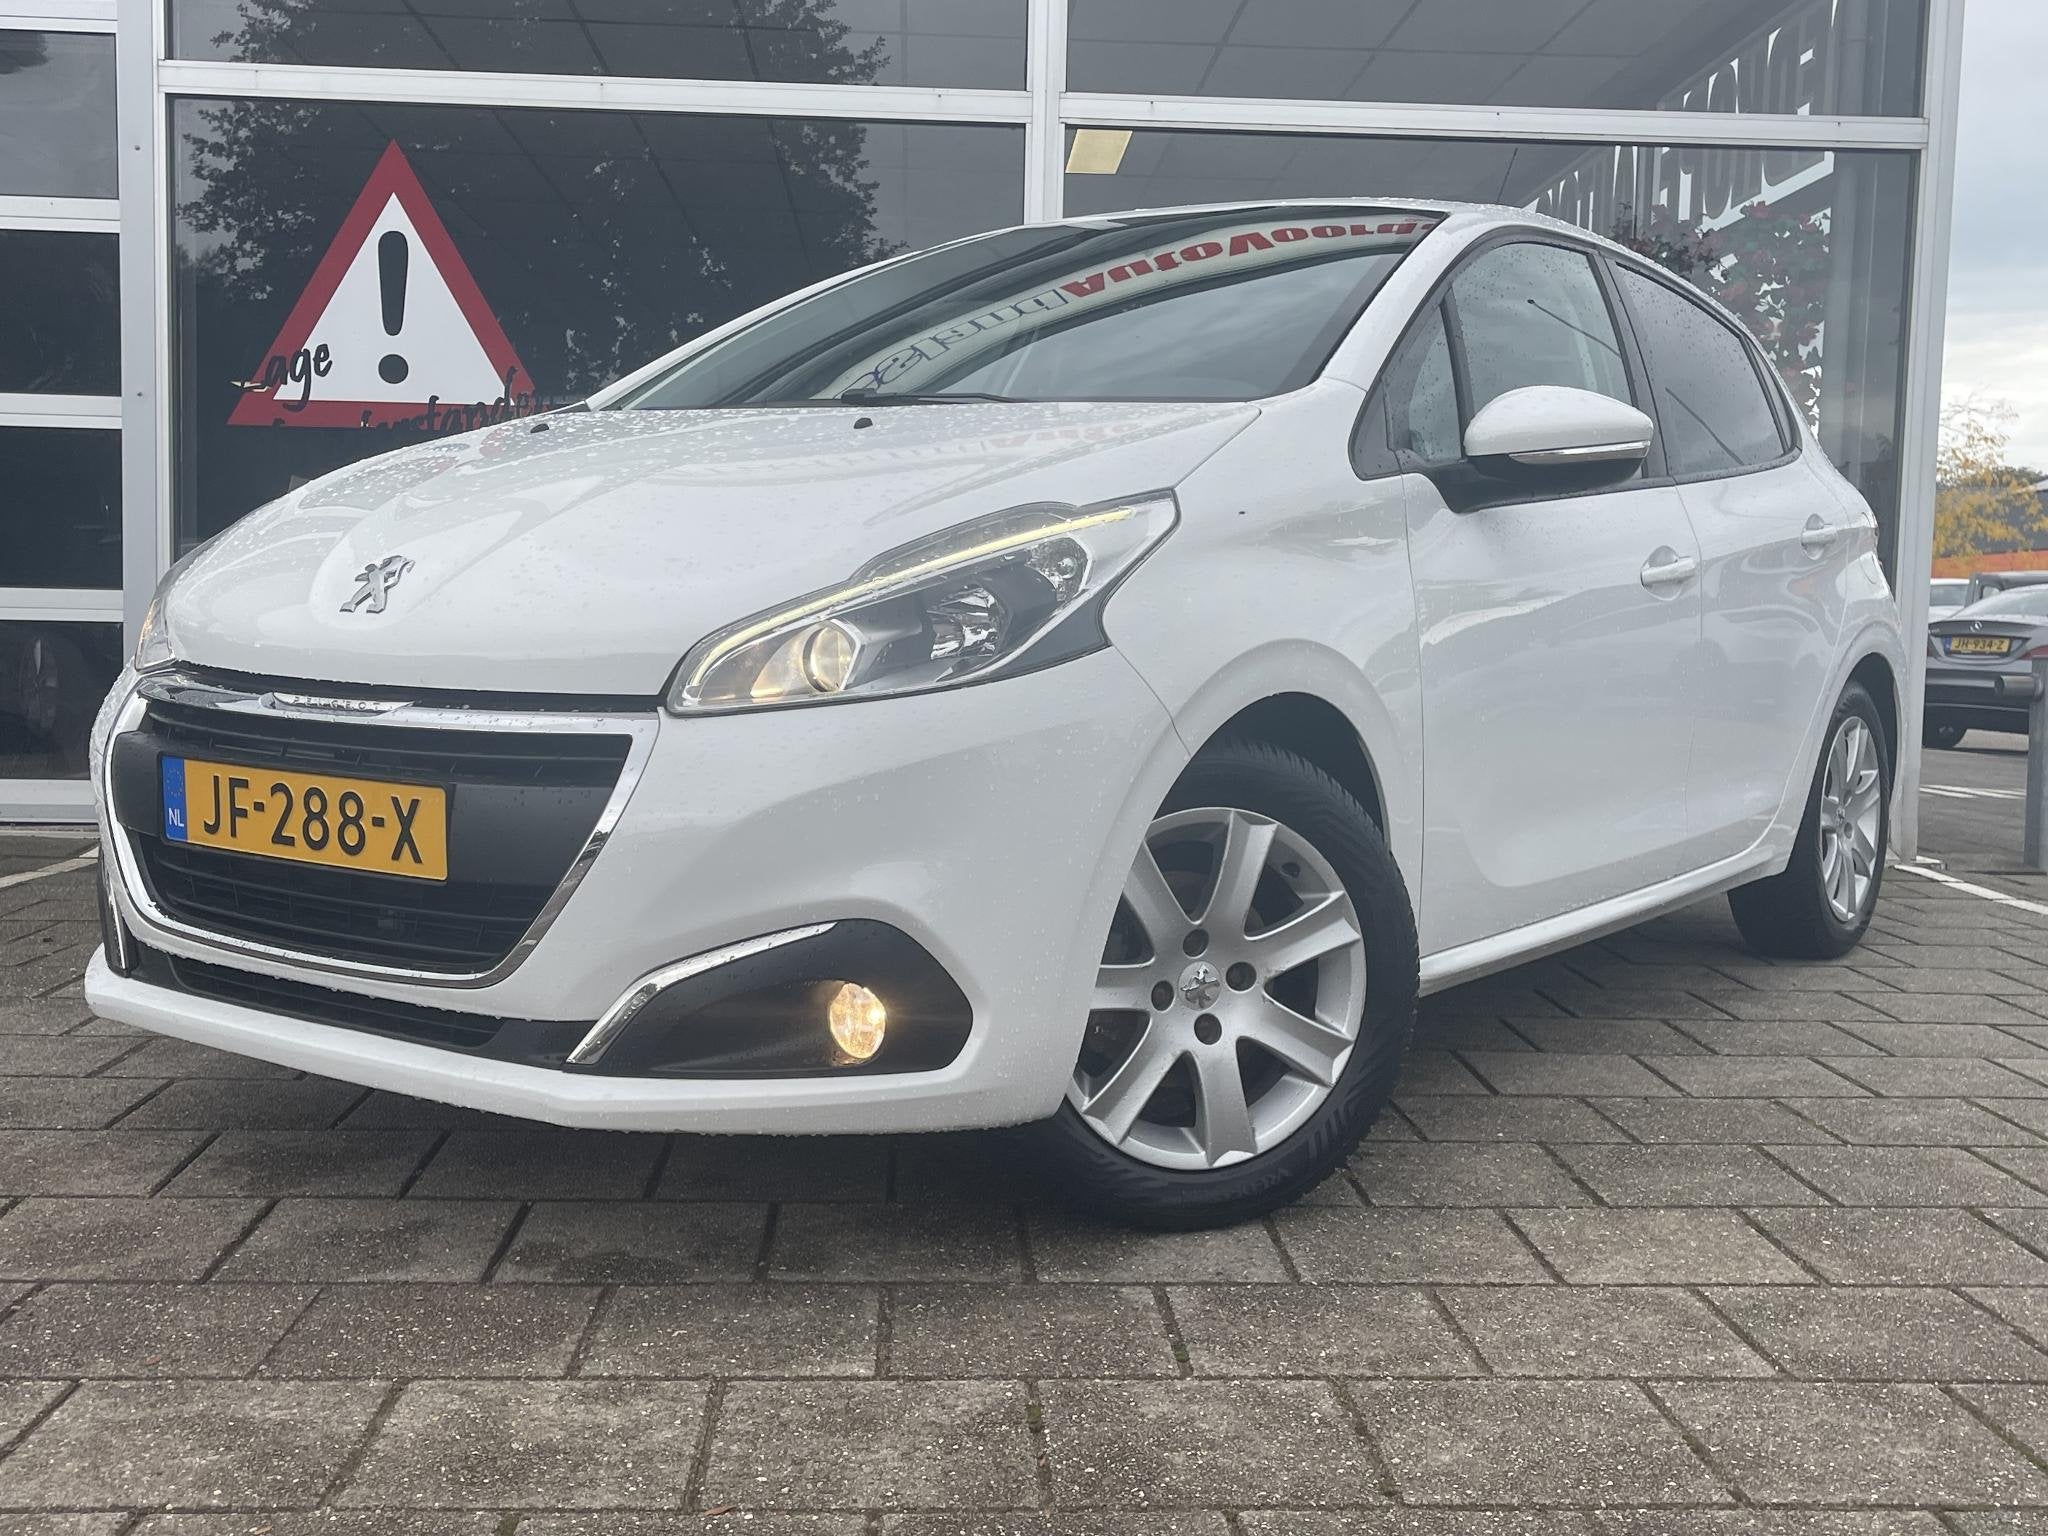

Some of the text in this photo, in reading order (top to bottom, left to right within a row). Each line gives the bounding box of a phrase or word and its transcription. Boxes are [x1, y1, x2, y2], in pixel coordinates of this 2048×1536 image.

[240, 343, 333, 411] age
[168, 807, 185, 828] NL
[203, 775, 423, 864] JF-288-X
